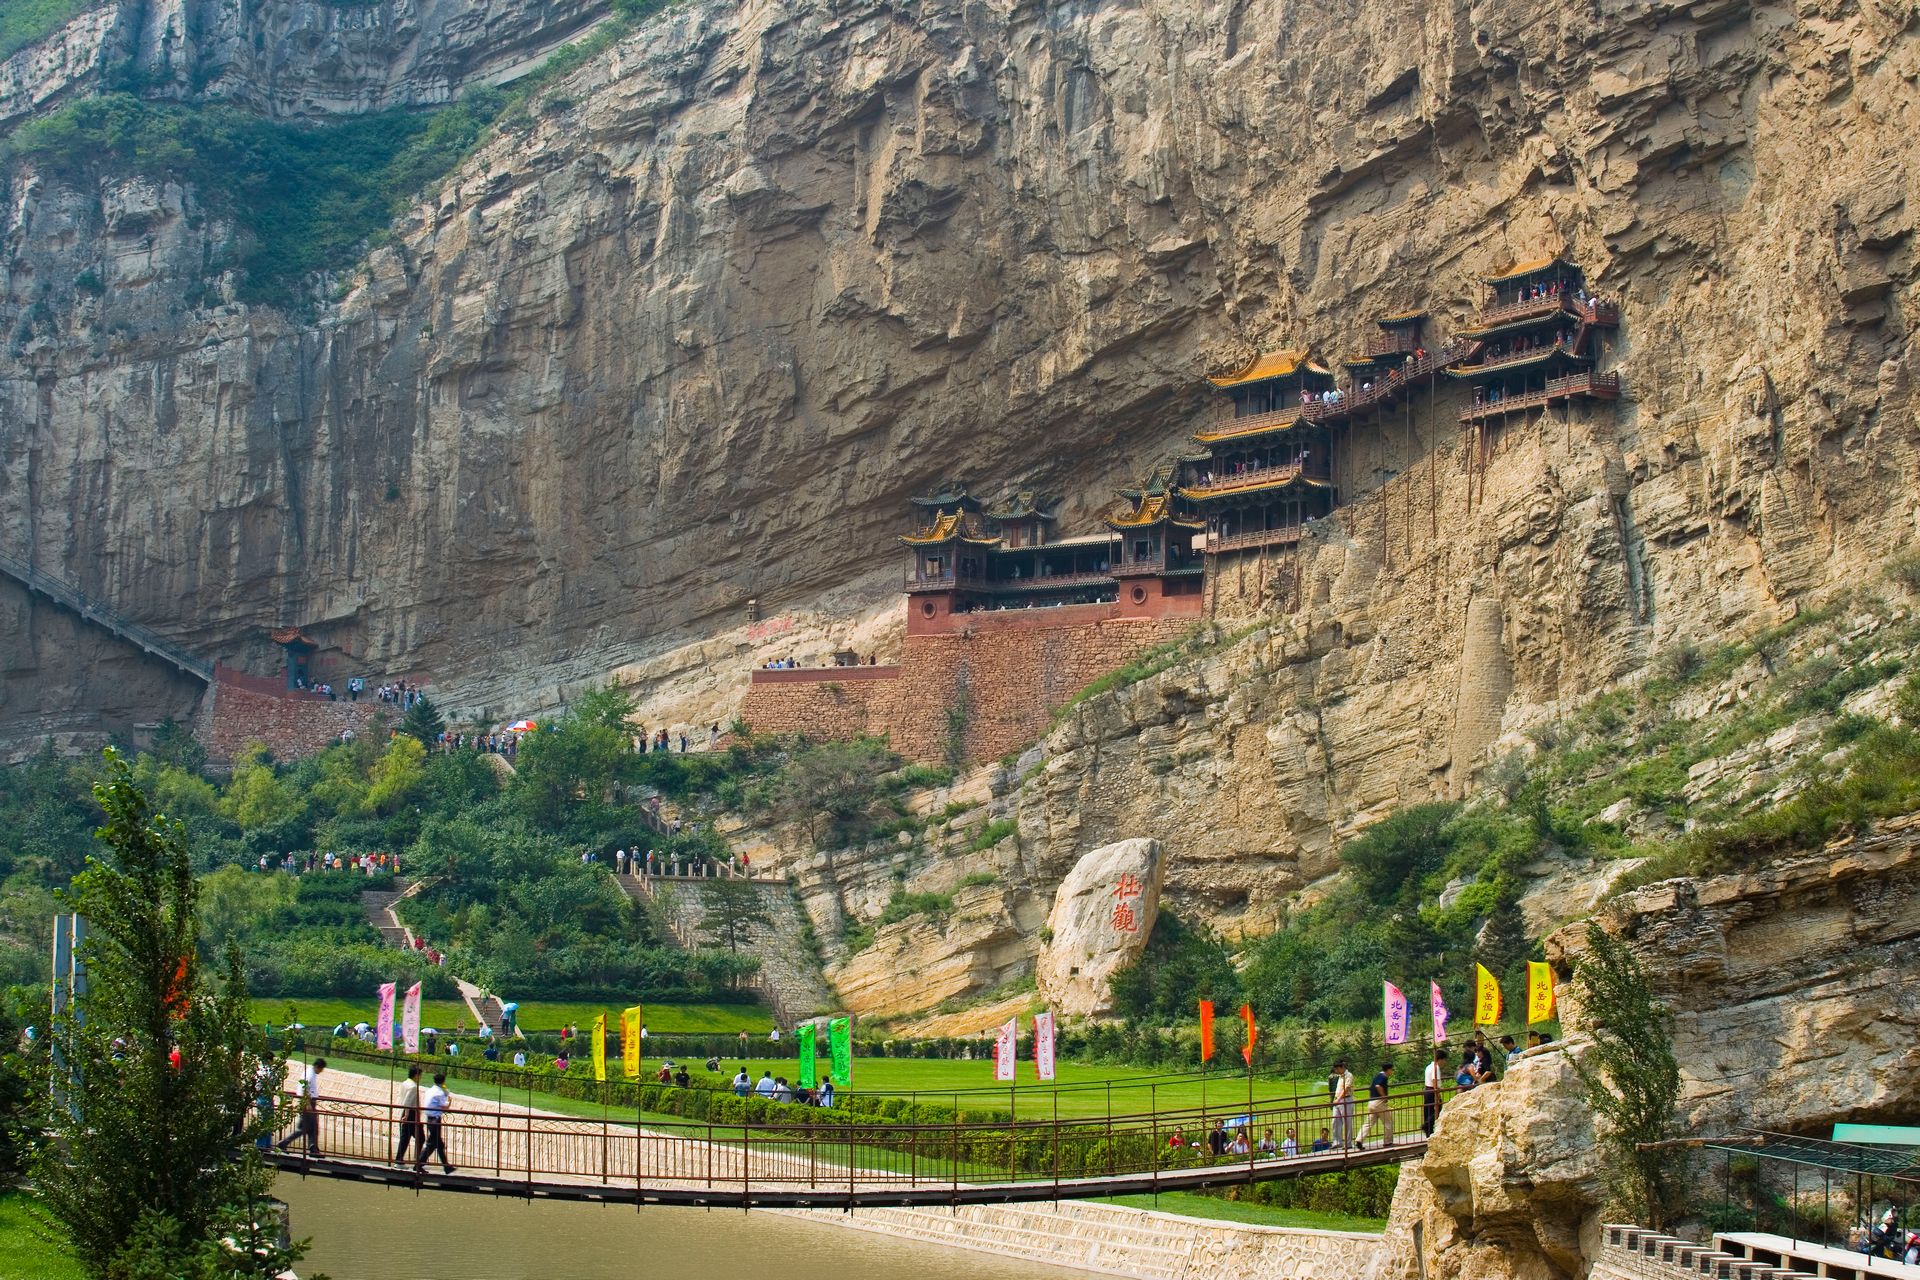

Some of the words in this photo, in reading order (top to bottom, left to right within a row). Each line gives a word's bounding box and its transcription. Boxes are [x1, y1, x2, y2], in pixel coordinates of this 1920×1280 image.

[1389, 1000, 1402, 1040] 北岳恒山
[1482, 981, 1495, 1020] 北岳恒山
